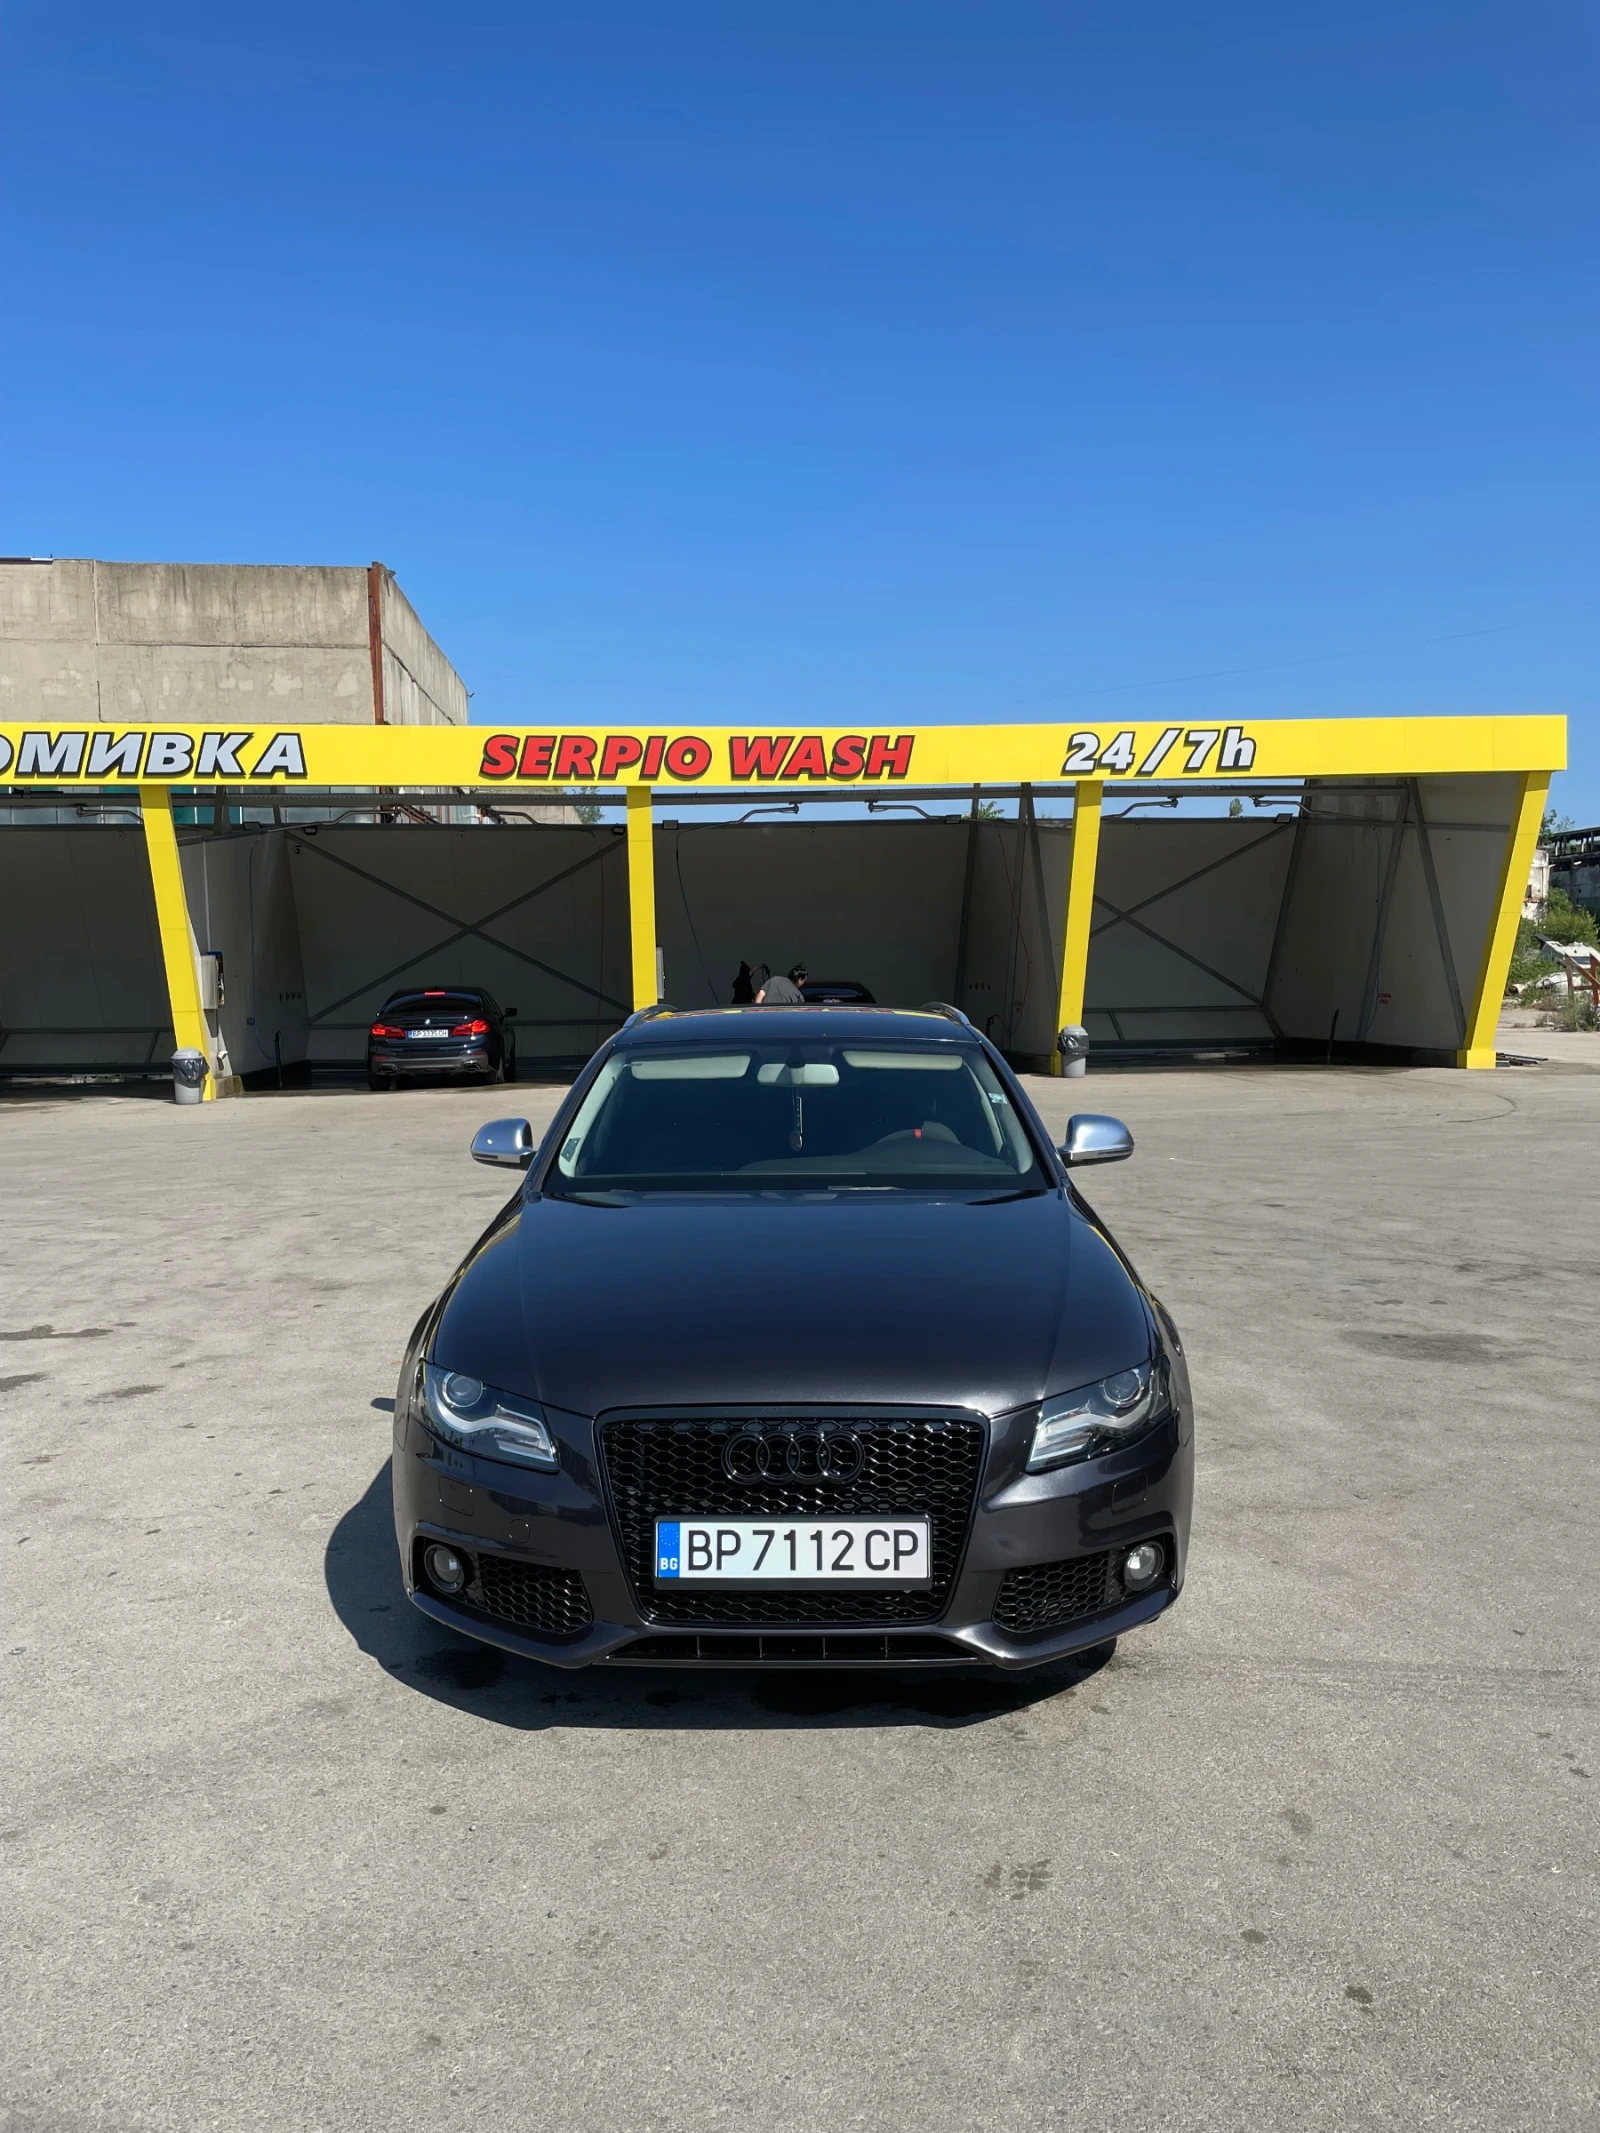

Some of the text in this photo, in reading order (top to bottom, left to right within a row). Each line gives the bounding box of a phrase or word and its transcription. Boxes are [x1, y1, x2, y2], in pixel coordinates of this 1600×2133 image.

[0, 731, 308, 779] МИВКА
[479, 734, 915, 780] SERPIO WASH
[1060, 726, 1257, 777] 24/7h
[660, 1558, 678, 1570] BG
